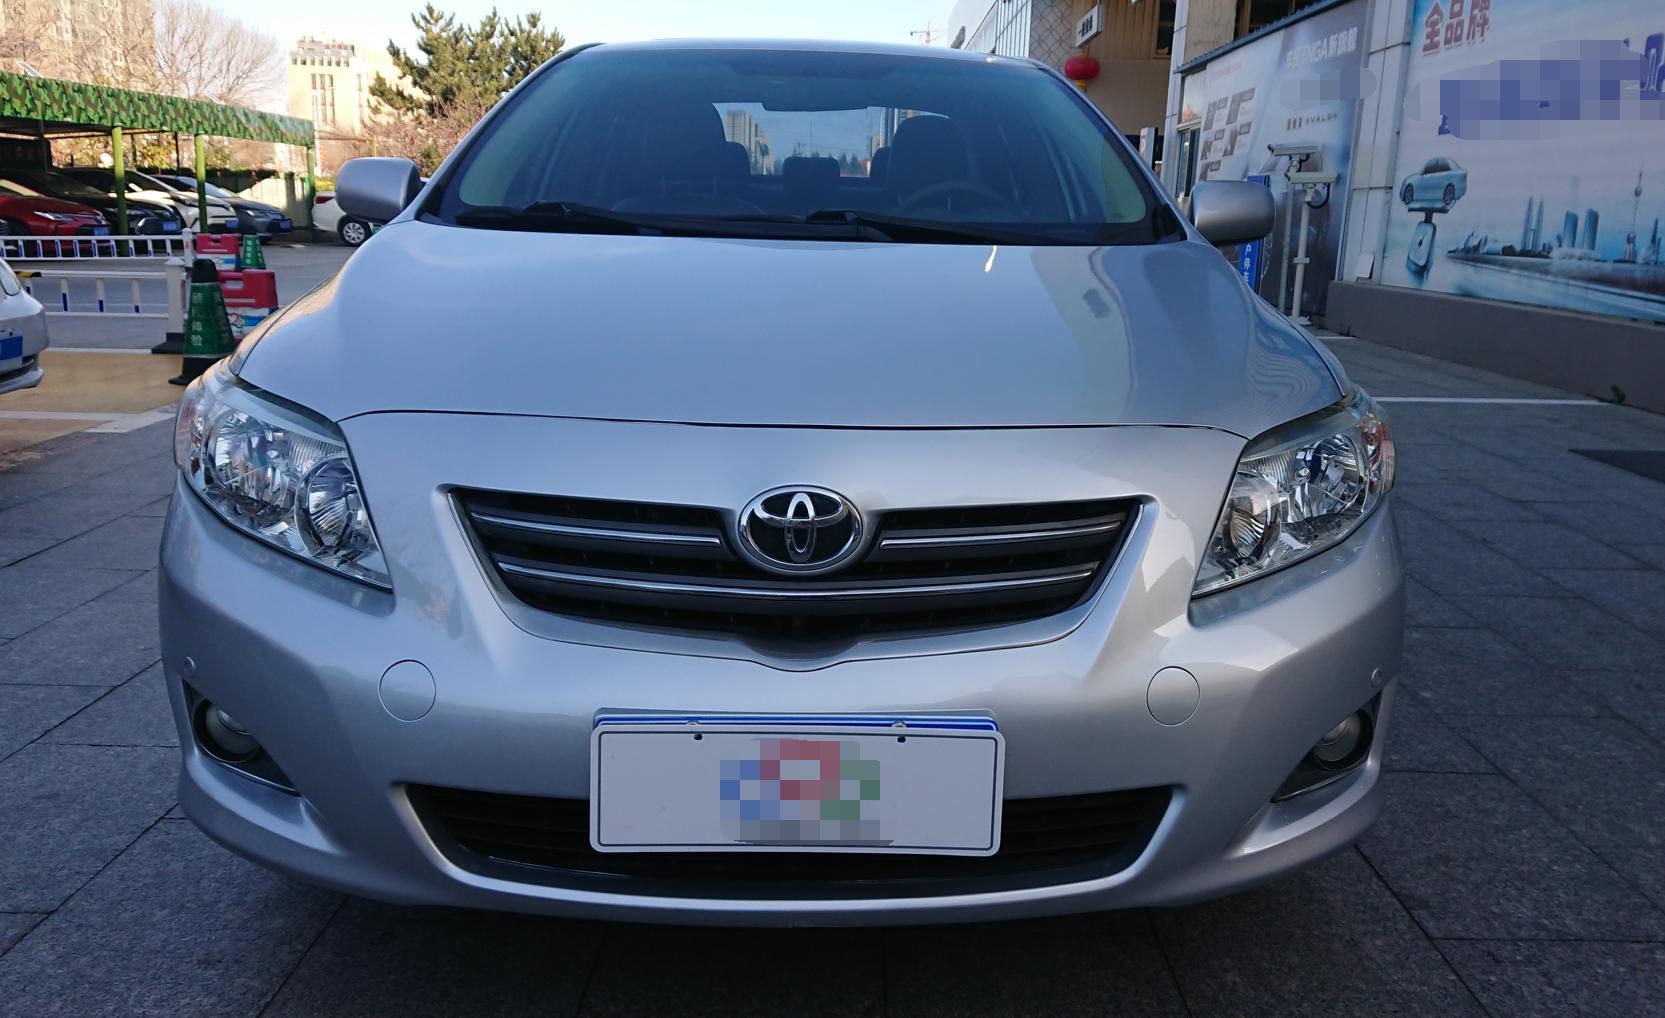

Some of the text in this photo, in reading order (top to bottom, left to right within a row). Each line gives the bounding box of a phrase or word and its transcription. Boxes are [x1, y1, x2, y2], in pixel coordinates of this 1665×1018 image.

[1422, 0, 1491, 54] 全品牌
[1304, 112, 1338, 125] AVALON
